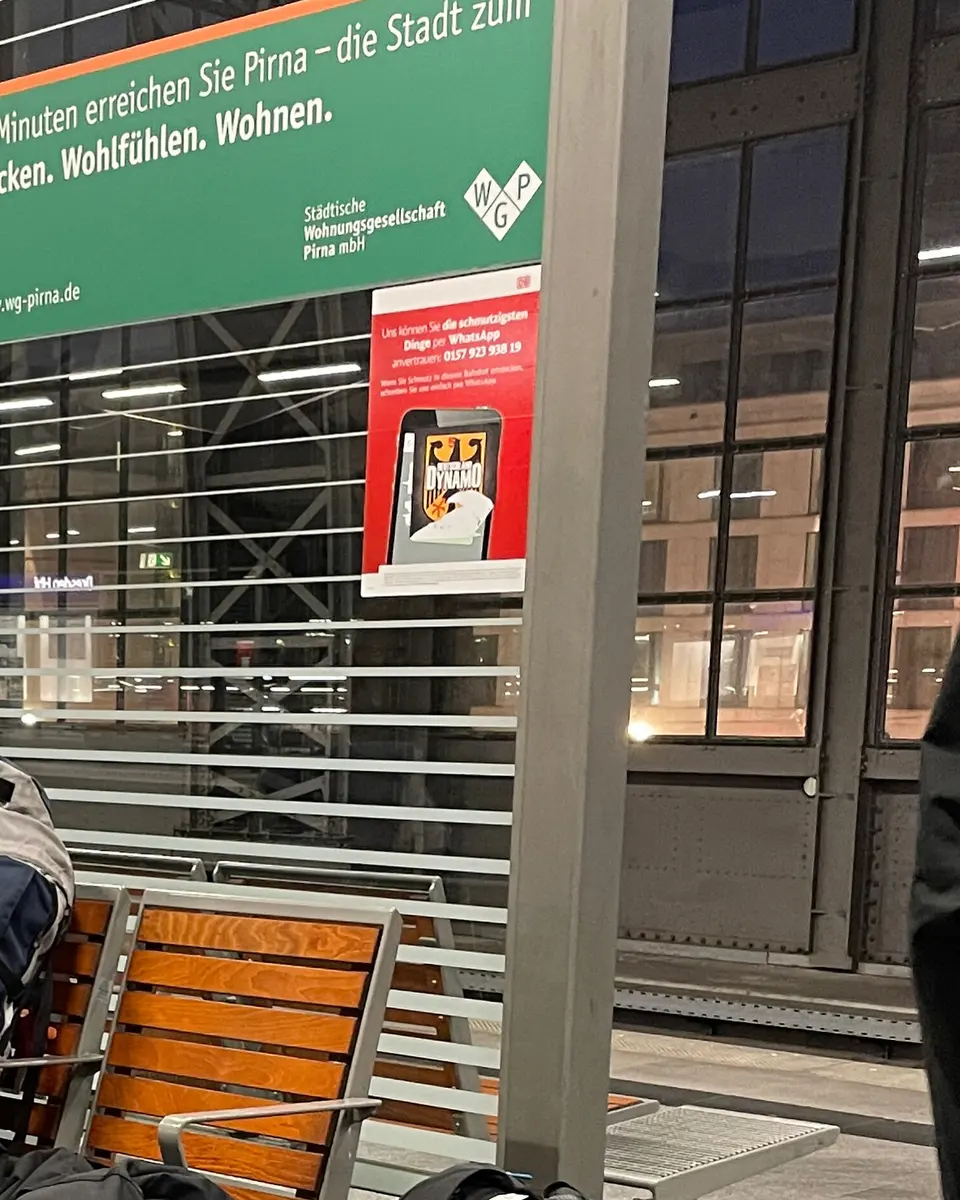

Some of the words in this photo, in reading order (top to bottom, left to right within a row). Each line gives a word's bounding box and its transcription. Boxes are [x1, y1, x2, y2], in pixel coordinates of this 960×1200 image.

[85, 75, 190, 124] erreichen
[198, 58, 235, 97] Sie
[244, 47, 307, 86] Pirna
[337, 22, 378, 63] die
[386, 0, 463, 51] Stadt
[471, 0, 531, 31] zum
[61, 123, 207, 180] Wohlfühlen.
[215, 97, 333, 146] Wohnen.
[303, 201, 446, 241] Wohnungsgesellschaft
[304, 197, 367, 223] Städtische
[303, 243, 336, 261] Pirna
[339, 235, 366, 254] mbH
[381, 328, 397, 339] Uns
[399, 324, 428, 336] können
[429, 321, 441, 334] Sie
[442, 318, 458, 331] die
[458, 310, 529, 329] schmutzigsten
[403, 339, 432, 352] Dinge
[432, 337, 447, 350] per
[448, 330, 501, 345] WhatsApp
[443, 349, 467, 362] 0157
[468, 346, 487, 358] 923
[488, 344, 508, 356] 938
[509, 341, 523, 353] 19
[426, 462, 482, 491] DYNAMO
